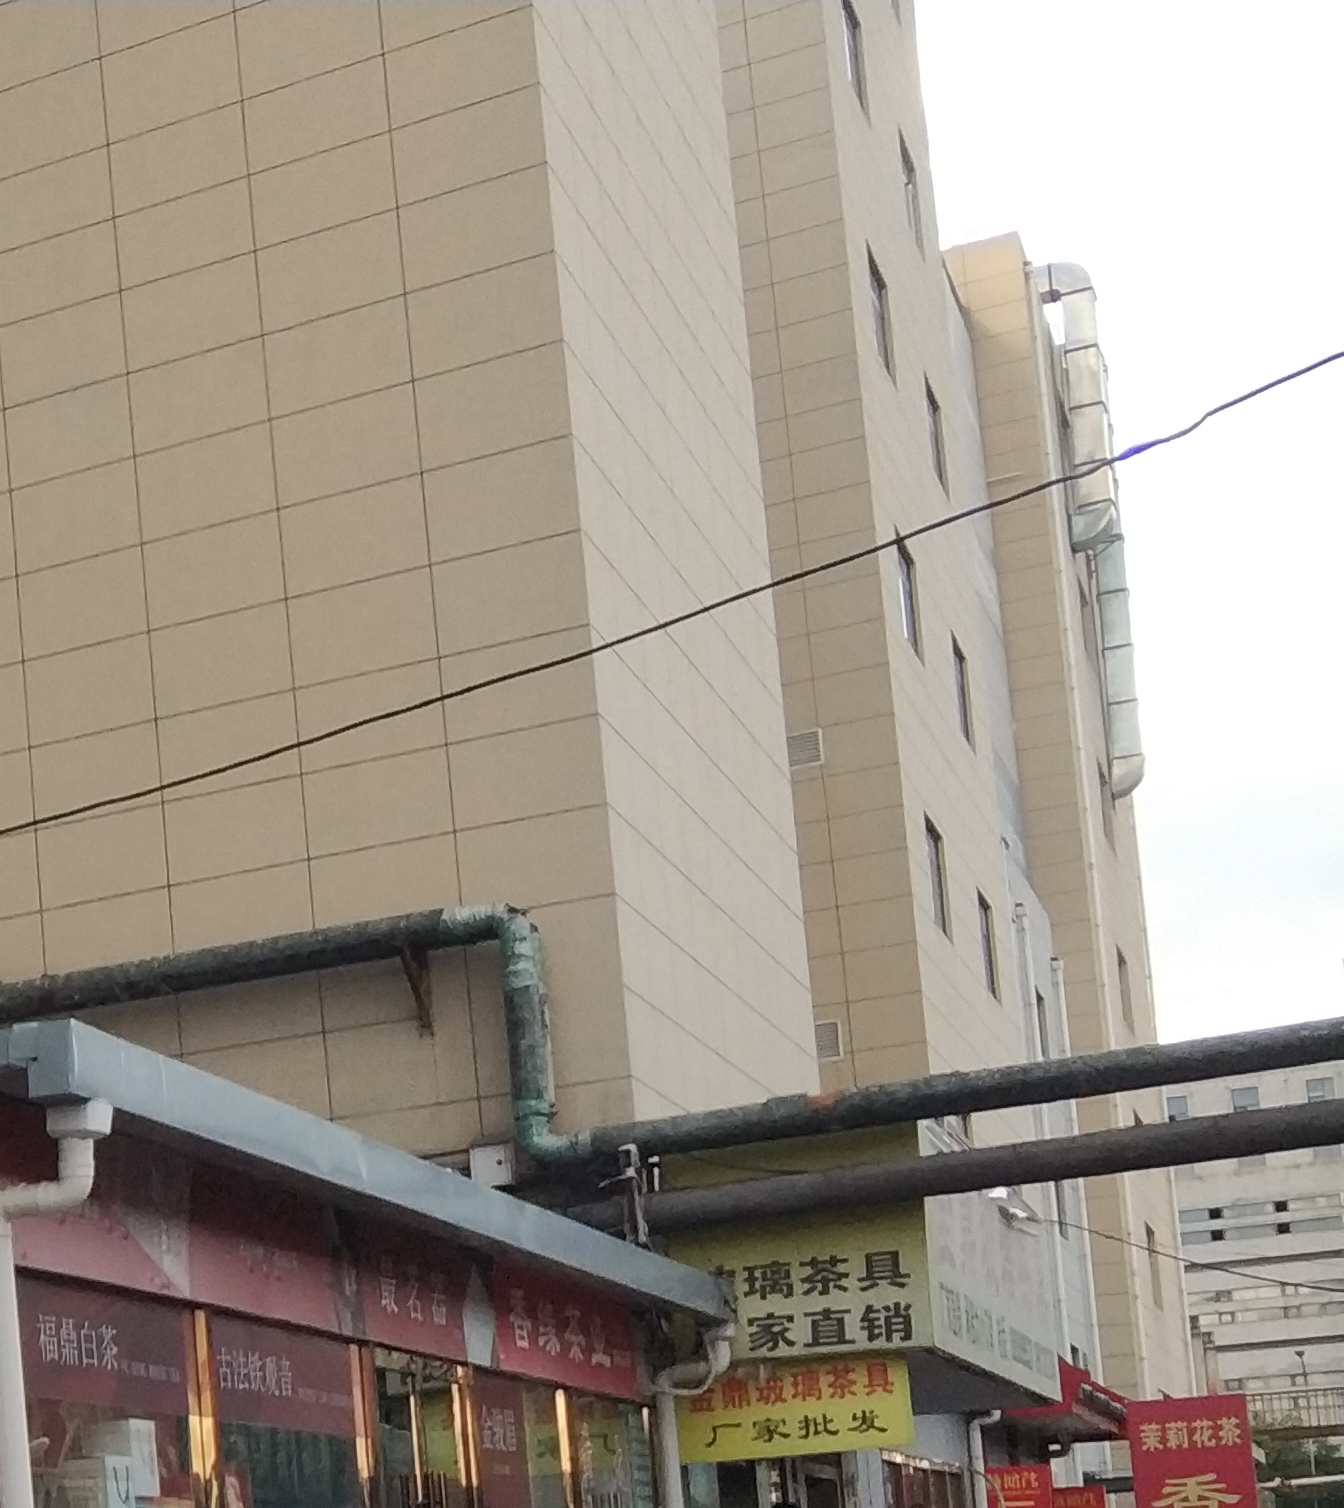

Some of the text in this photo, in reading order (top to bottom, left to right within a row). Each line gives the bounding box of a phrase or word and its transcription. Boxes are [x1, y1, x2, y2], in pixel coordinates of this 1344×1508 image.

[36, 1312, 119, 1372] 福鼎白茶
[216, 1346, 294, 1398] 古法铁观音
[704, 1408, 889, 1449] 厂家批发
[1139, 1416, 1243, 1454] 茉莉花茶
